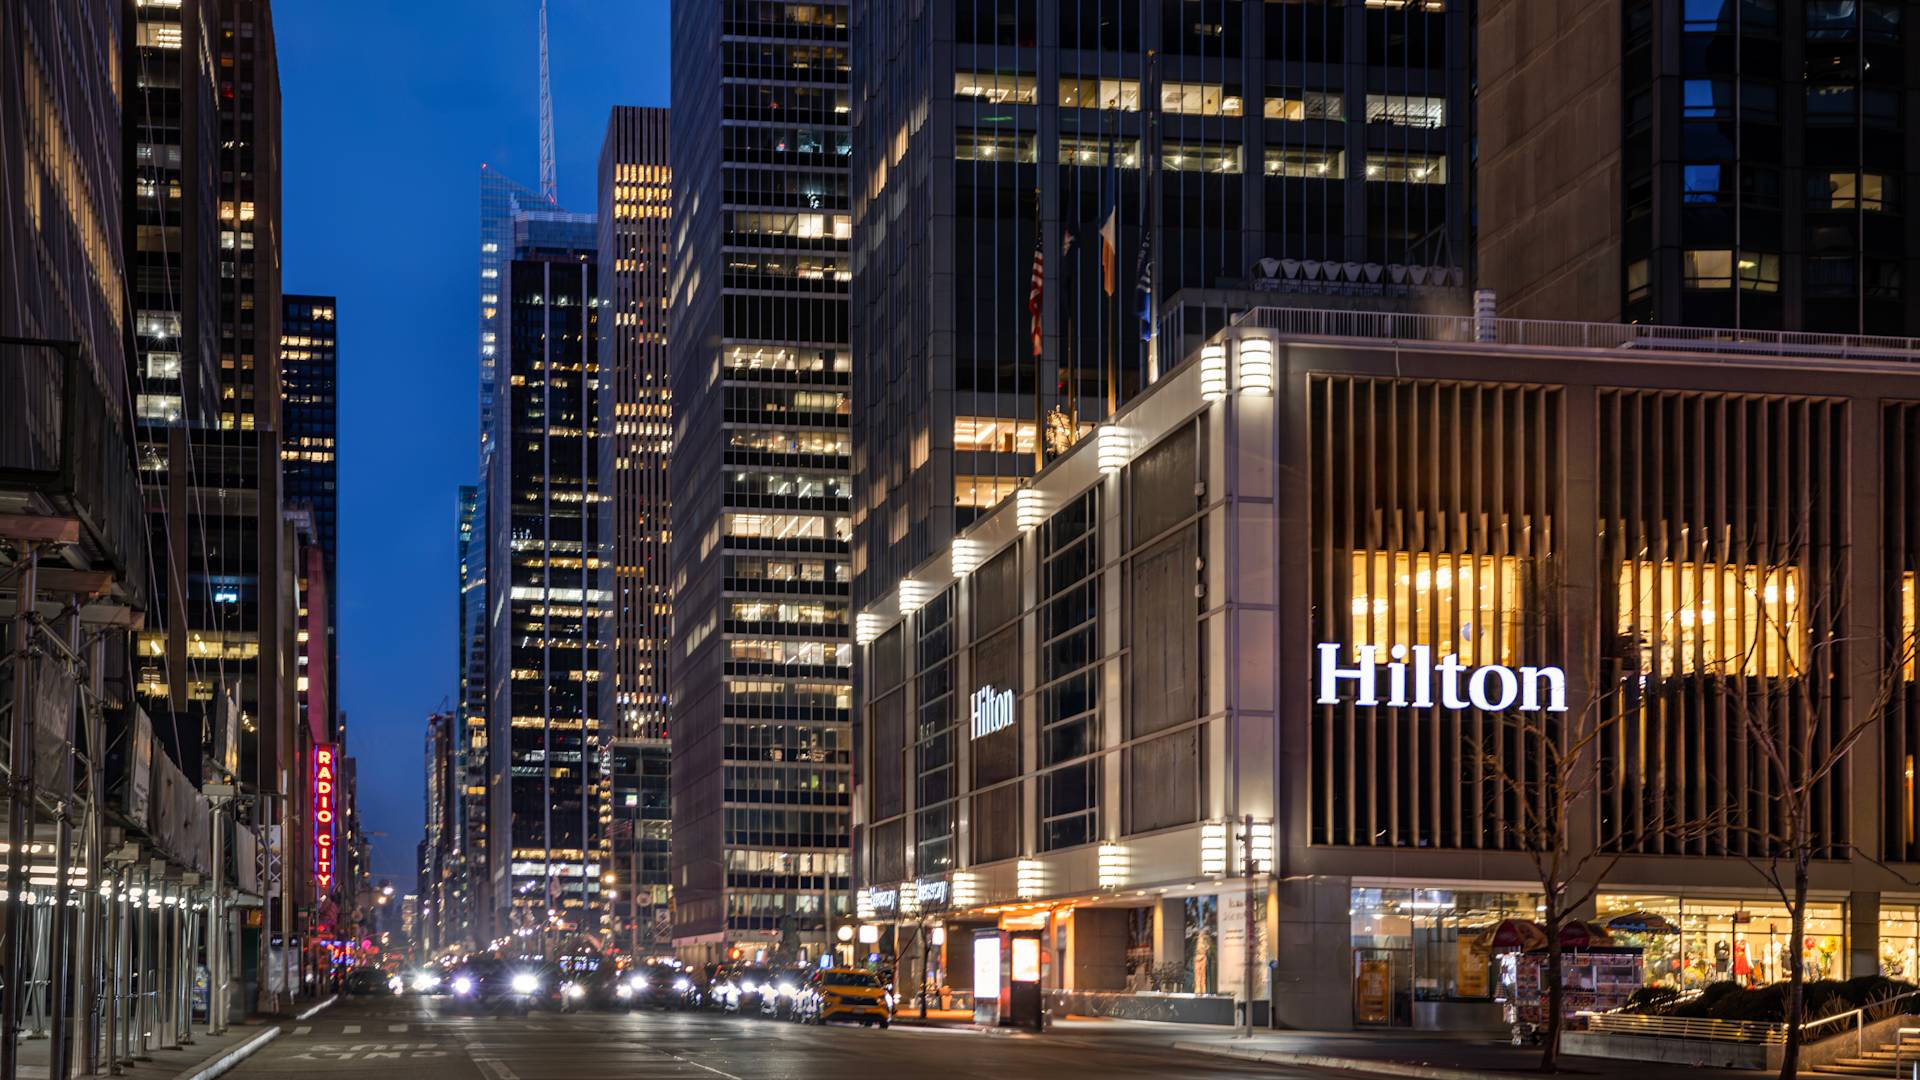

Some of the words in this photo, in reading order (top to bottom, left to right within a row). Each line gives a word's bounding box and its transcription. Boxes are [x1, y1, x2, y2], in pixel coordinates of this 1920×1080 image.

[1317, 643, 1568, 711] Hilton
[970, 684, 1013, 740] Hilton
[318, 751, 332, 823] RADIO
[318, 834, 331, 886] CITY
